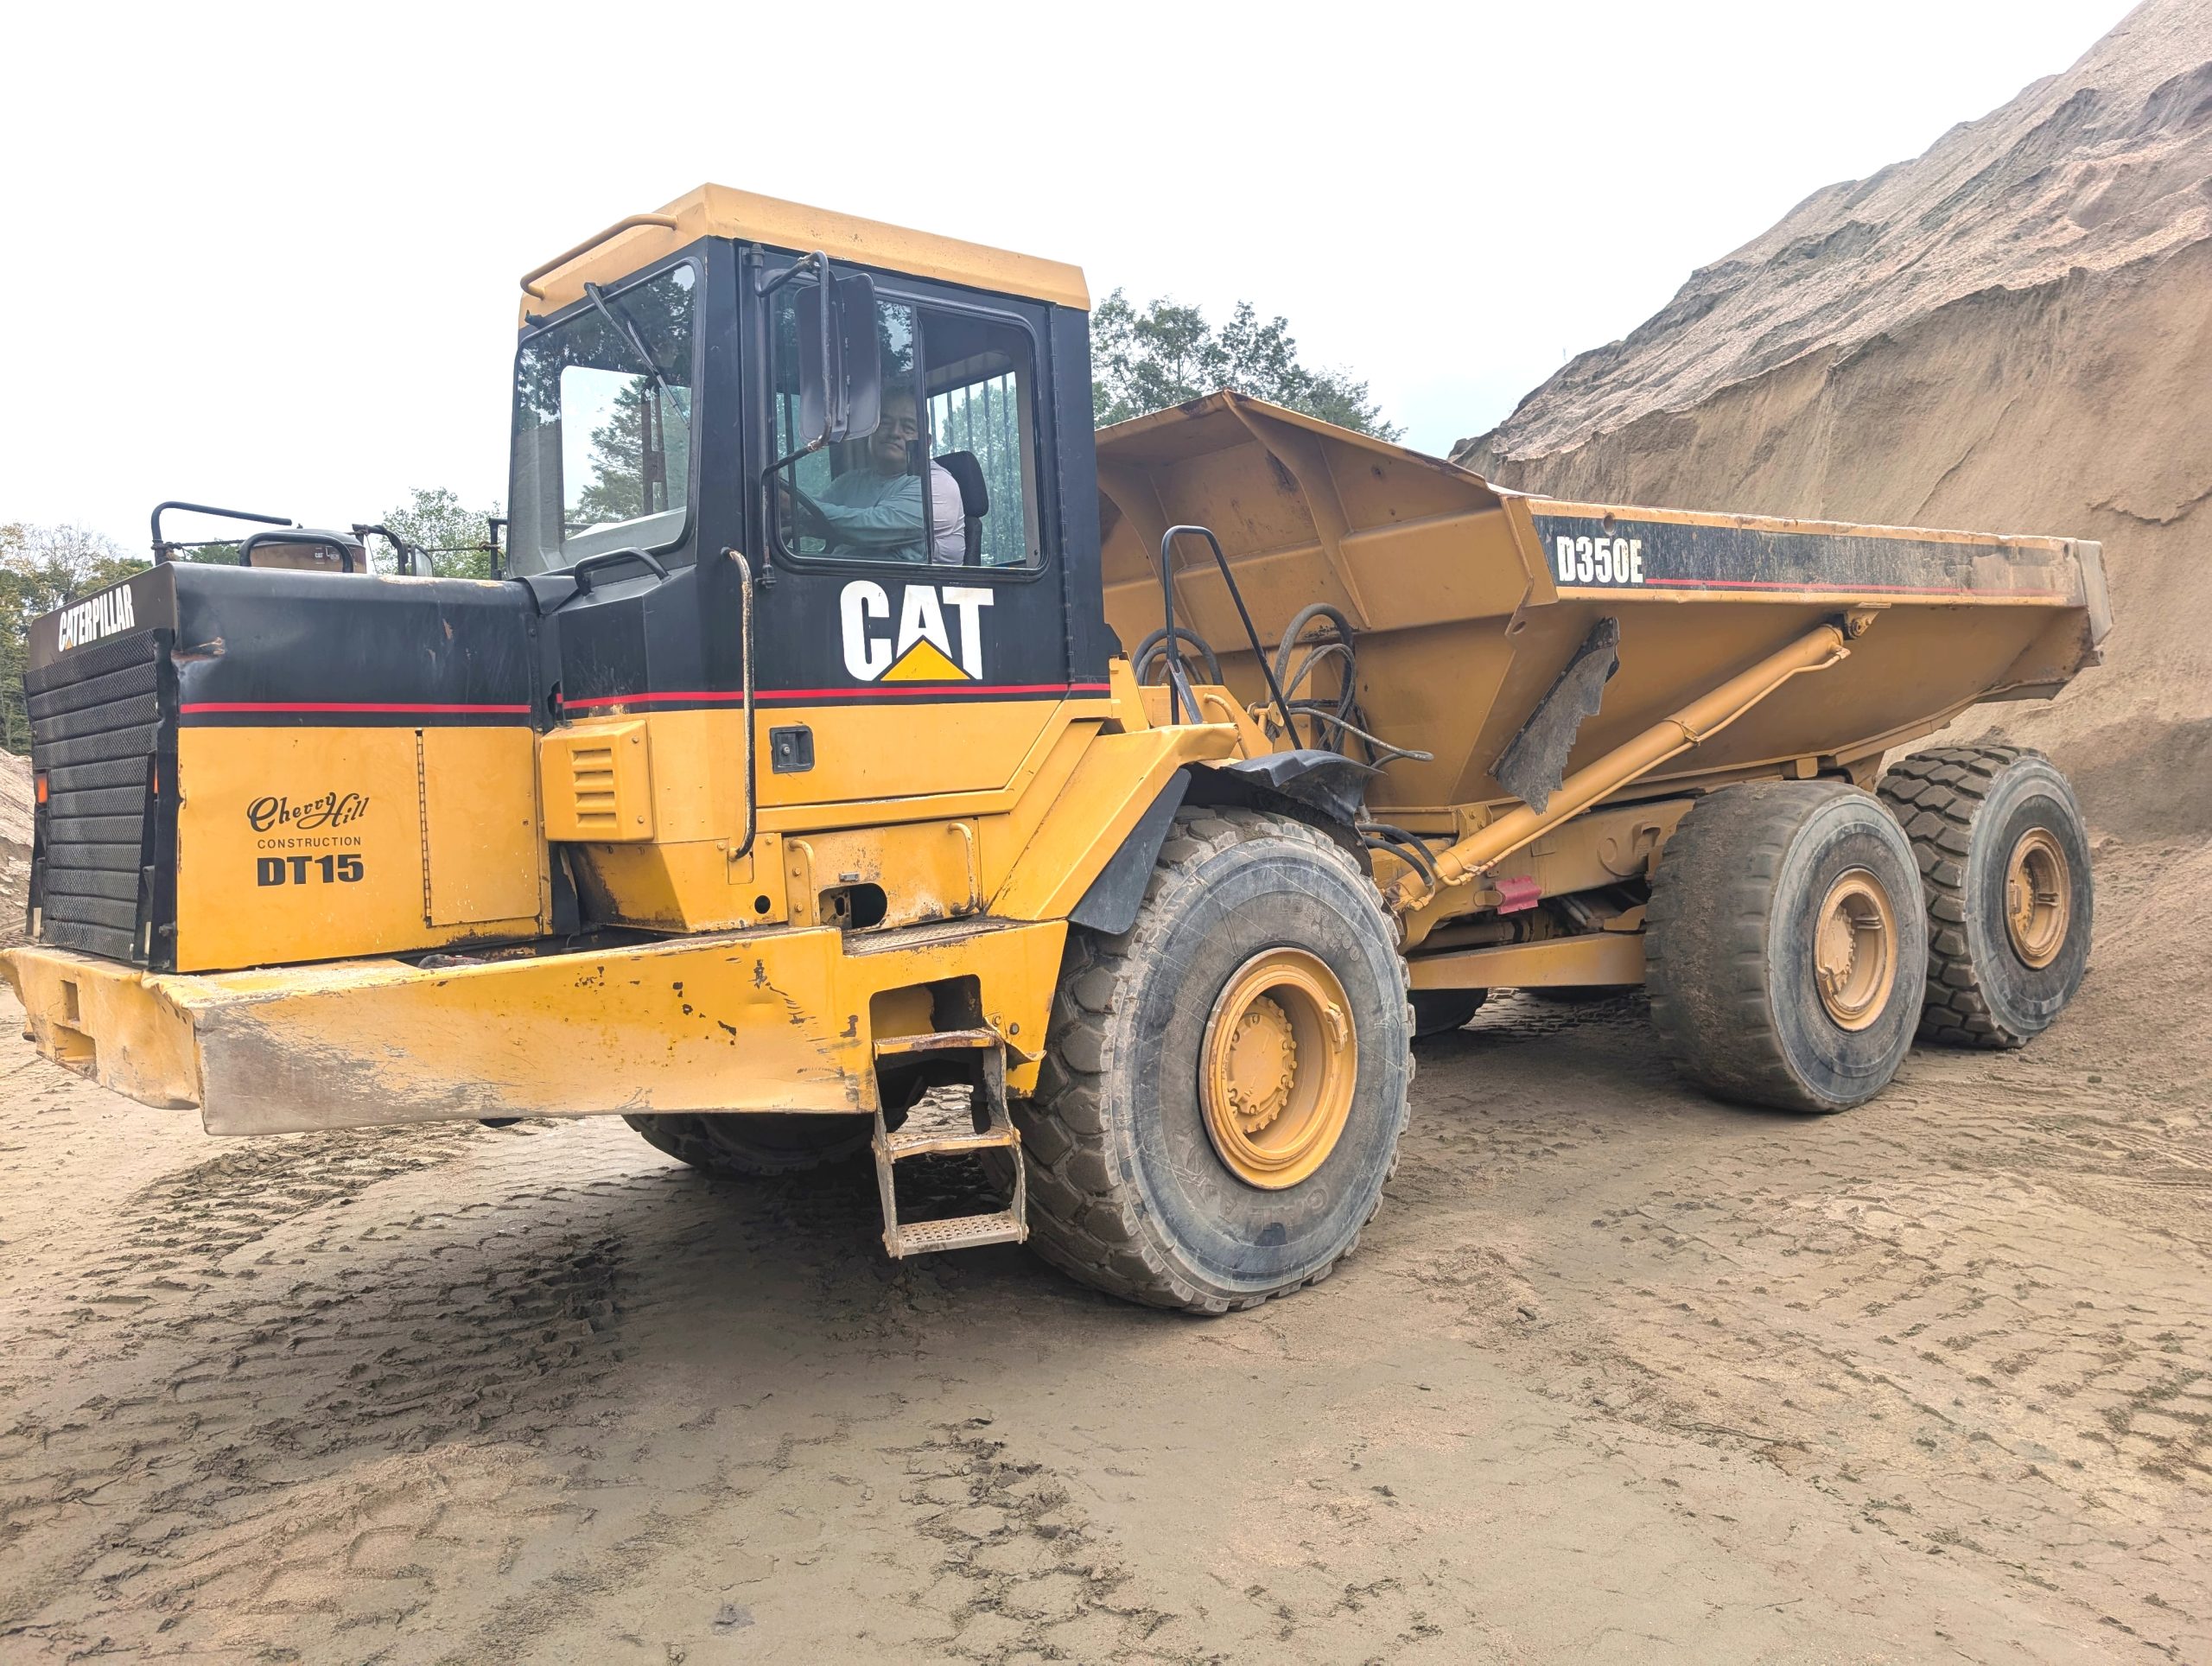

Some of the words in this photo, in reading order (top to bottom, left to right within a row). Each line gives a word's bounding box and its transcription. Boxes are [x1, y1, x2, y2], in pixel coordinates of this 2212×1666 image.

[1556, 536, 1643, 583] D350E
[58, 583, 136, 652] CATERPILLAR
[840, 580, 994, 681] CAT
[246, 792, 337, 832] Cherry
[318, 792, 369, 828] Hill
[257, 836, 361, 849] CONSTRUCTION
[257, 854, 364, 887] DT15
